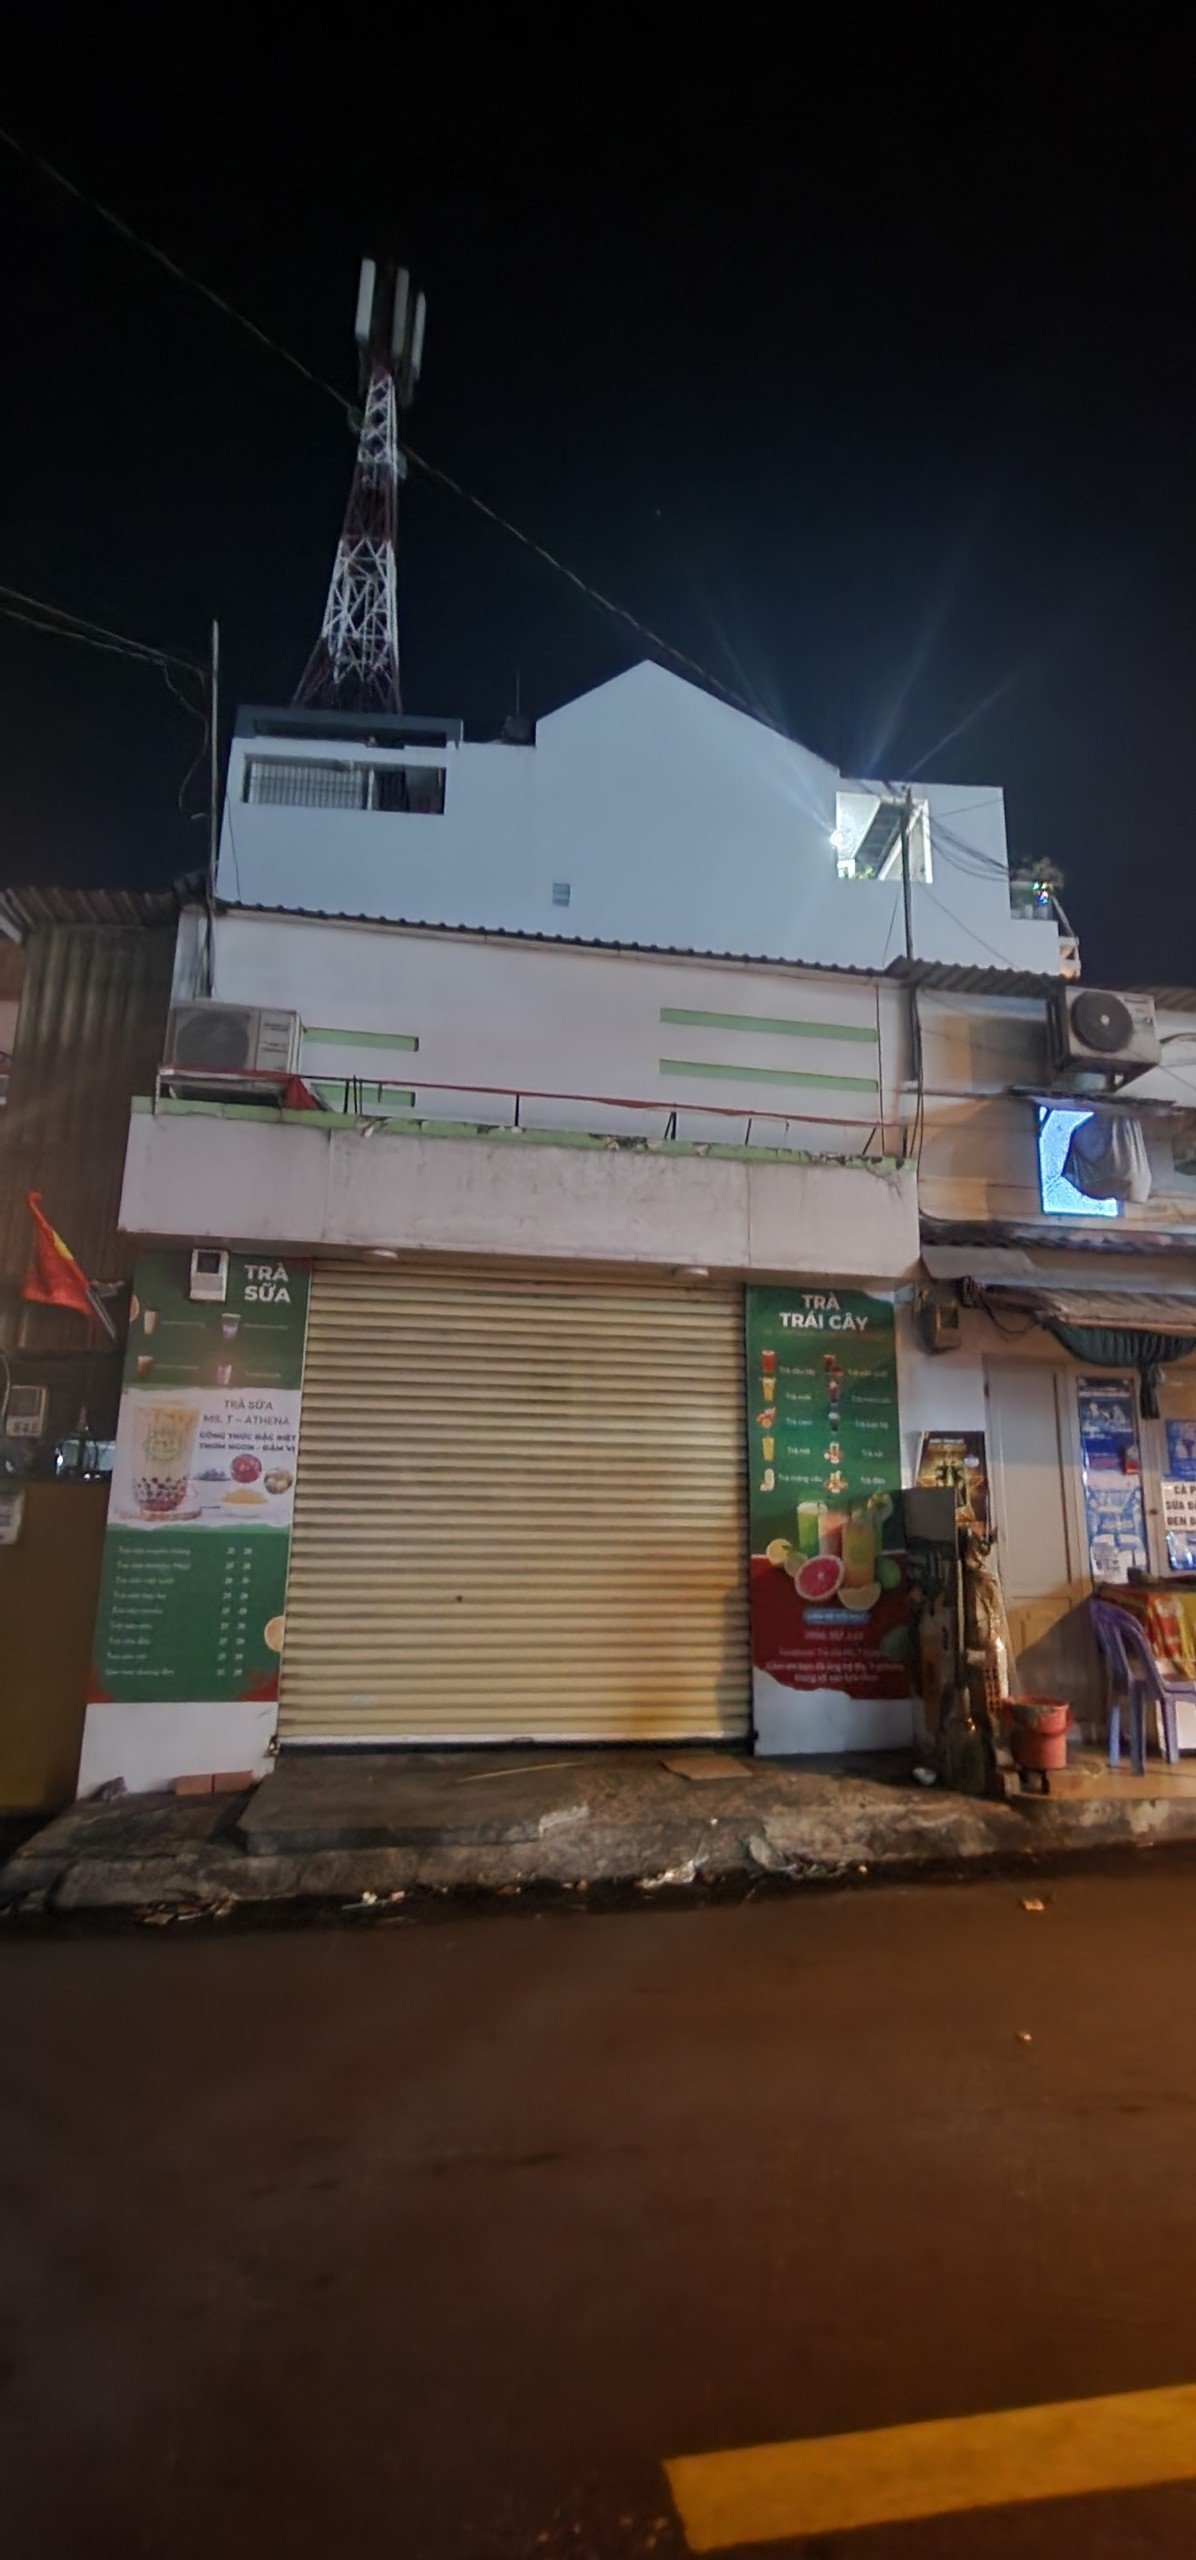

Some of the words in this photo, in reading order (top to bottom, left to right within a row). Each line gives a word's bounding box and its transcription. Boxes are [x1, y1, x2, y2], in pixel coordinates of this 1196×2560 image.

[244, 1262, 289, 1282] TRÀ
[244, 1282, 291, 1303] SỮA
[801, 1292, 840, 1310] TRÀ
[779, 1310, 824, 1329] TRÁI
[828, 1312, 868, 1331] CÂY
[224, 1399, 246, 1410] TRÀ
[247, 1400, 273, 1410] SỮA
[244, 1415, 290, 1425] ATHENA
